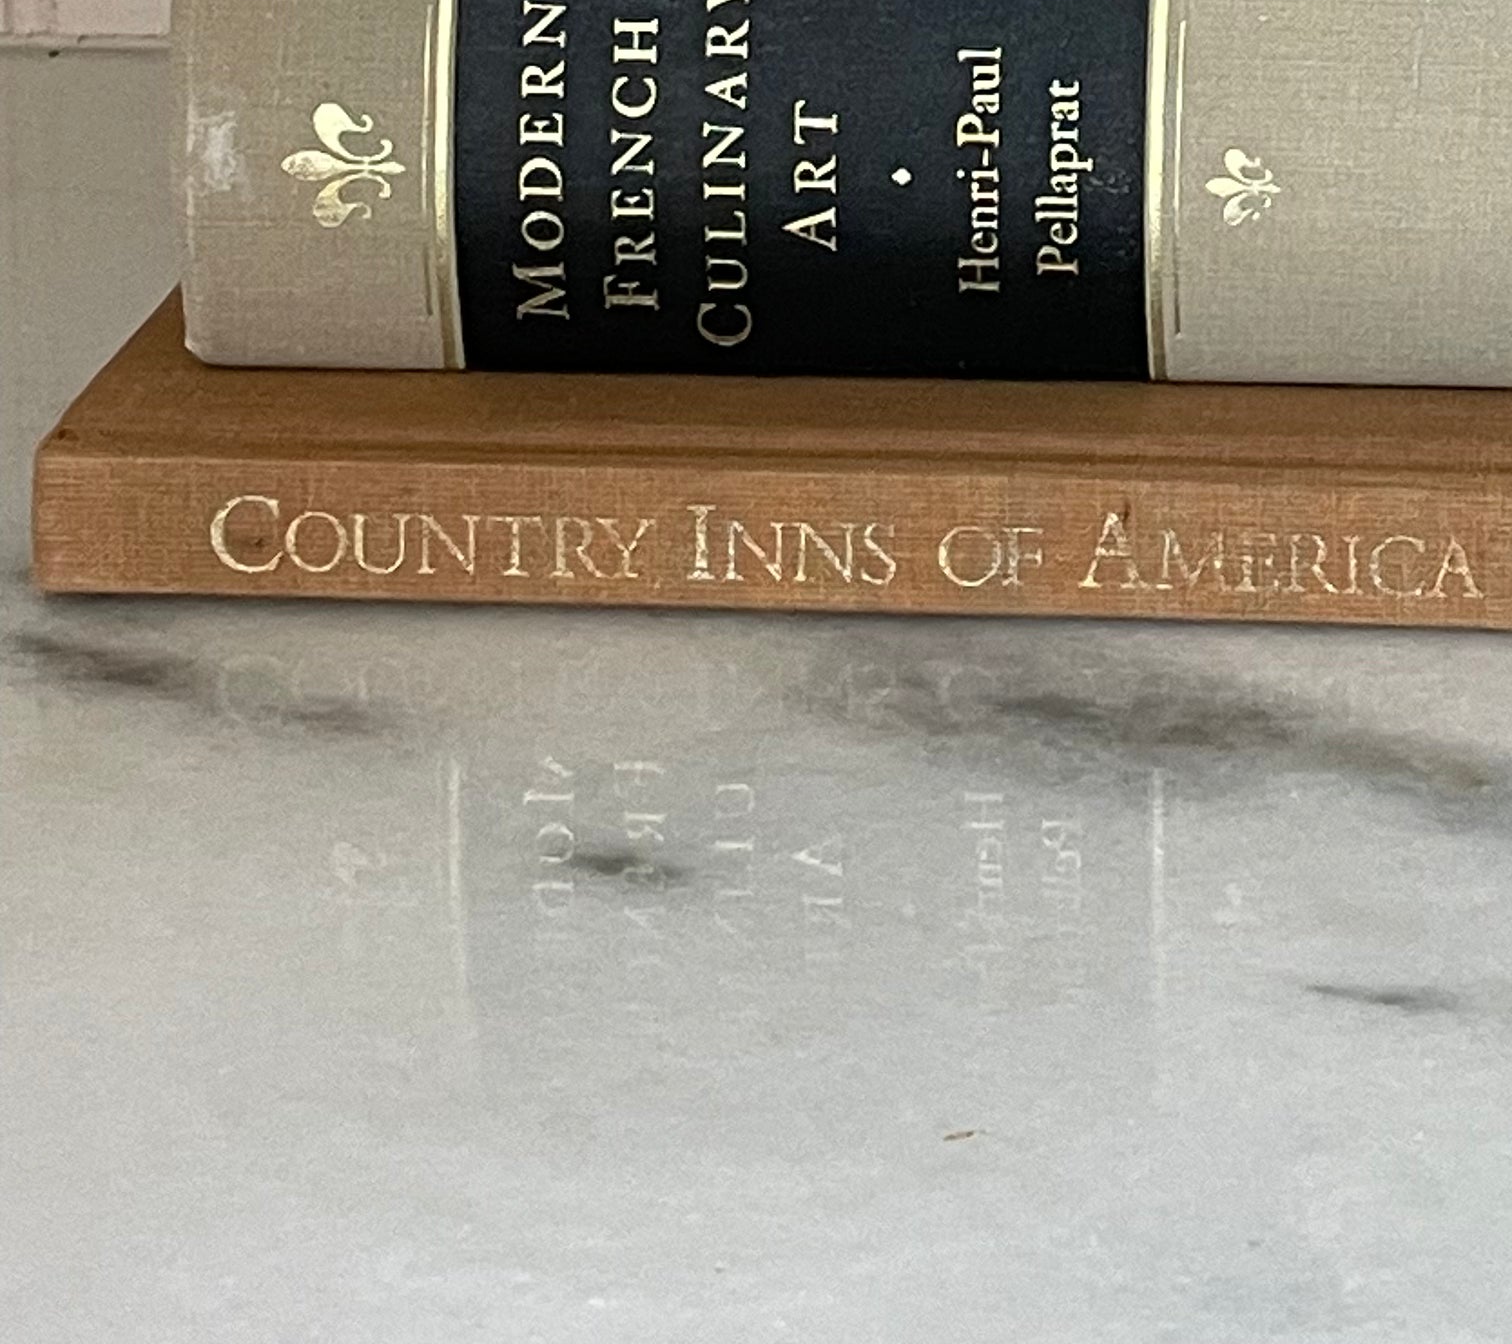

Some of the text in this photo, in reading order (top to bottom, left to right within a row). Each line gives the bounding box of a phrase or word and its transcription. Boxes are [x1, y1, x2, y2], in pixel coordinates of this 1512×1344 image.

[512, 0, 569, 320] MODERN
[603, 17, 660, 311] FRENCH
[782, 99, 839, 253] ART
[956, 46, 1003, 293] Henri-Paul
[1035, 79, 1095, 276] Pellaprat
[208, 493, 656, 580] COUNTRY
[685, 503, 898, 587] INNS
[937, 524, 1046, 589] OF
[1078, 510, 1483, 601] AMERICA
